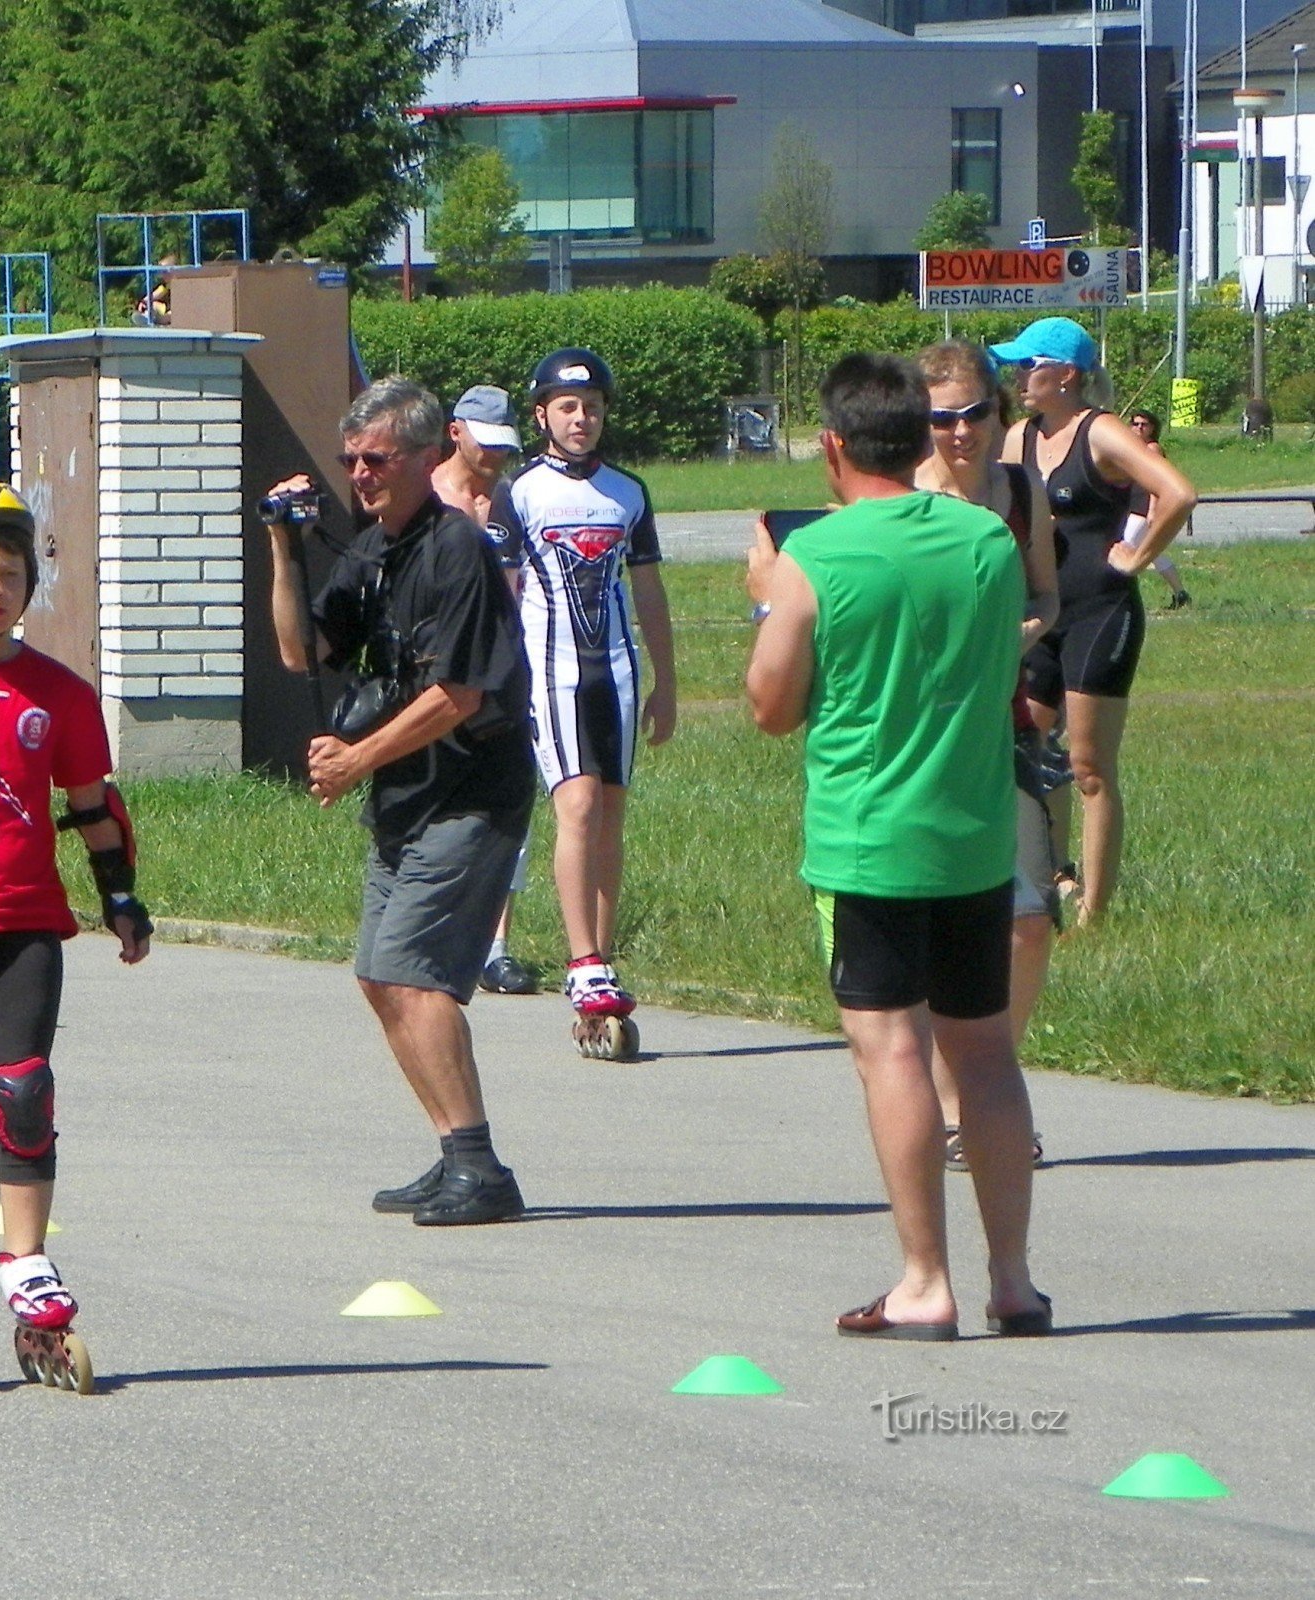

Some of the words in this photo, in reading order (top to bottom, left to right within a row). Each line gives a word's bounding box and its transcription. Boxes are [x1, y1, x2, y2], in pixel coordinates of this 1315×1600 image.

[929, 253, 1062, 281] BOWLING
[1106, 250, 1120, 304] SAUNA
[929, 288, 1034, 305] RESTAURACE
